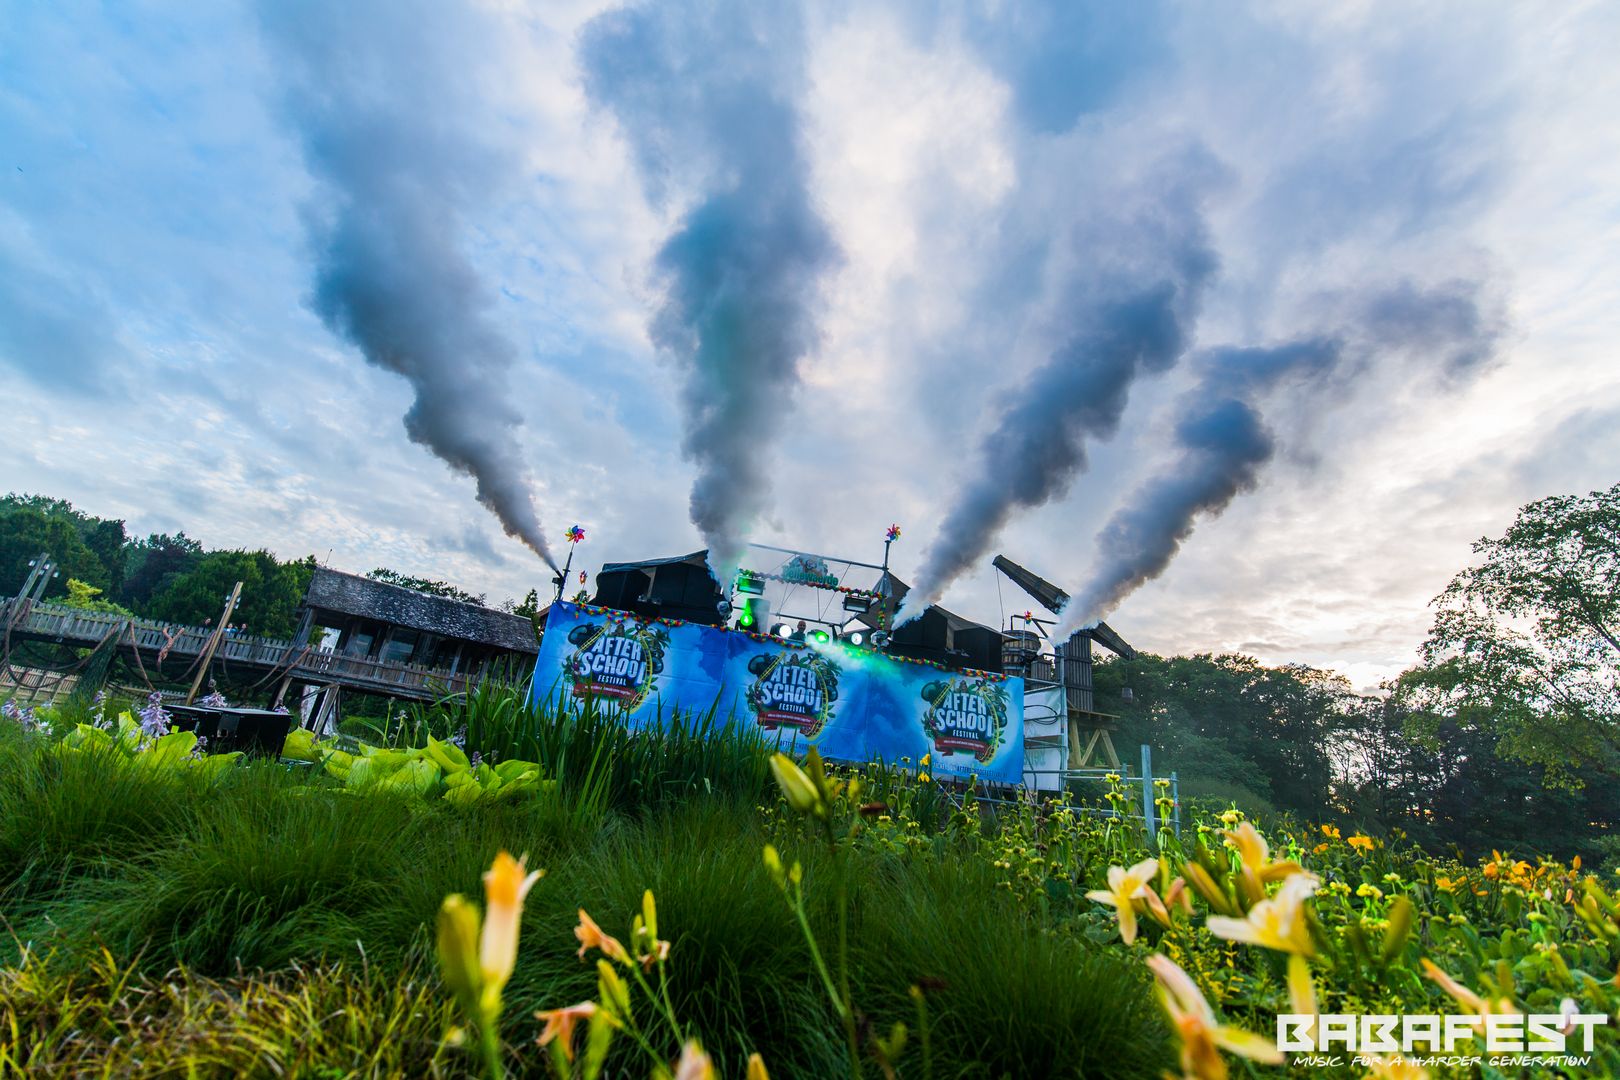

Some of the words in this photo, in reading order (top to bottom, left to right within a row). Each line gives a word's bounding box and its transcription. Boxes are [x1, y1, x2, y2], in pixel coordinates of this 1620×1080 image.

[591, 635, 643, 661] AFTER
[579, 652, 647, 684] SCHOOL
[597, 675, 627, 686] FESTIVAL
[770, 664, 817, 689] AFTER
[761, 681, 822, 711] SCHOOL
[778, 703, 806, 714] FESTIVAL
[943, 691, 987, 715] AFTER
[935, 708, 993, 737] SCHOOL
[952, 730, 979, 740] FESTIVAL
